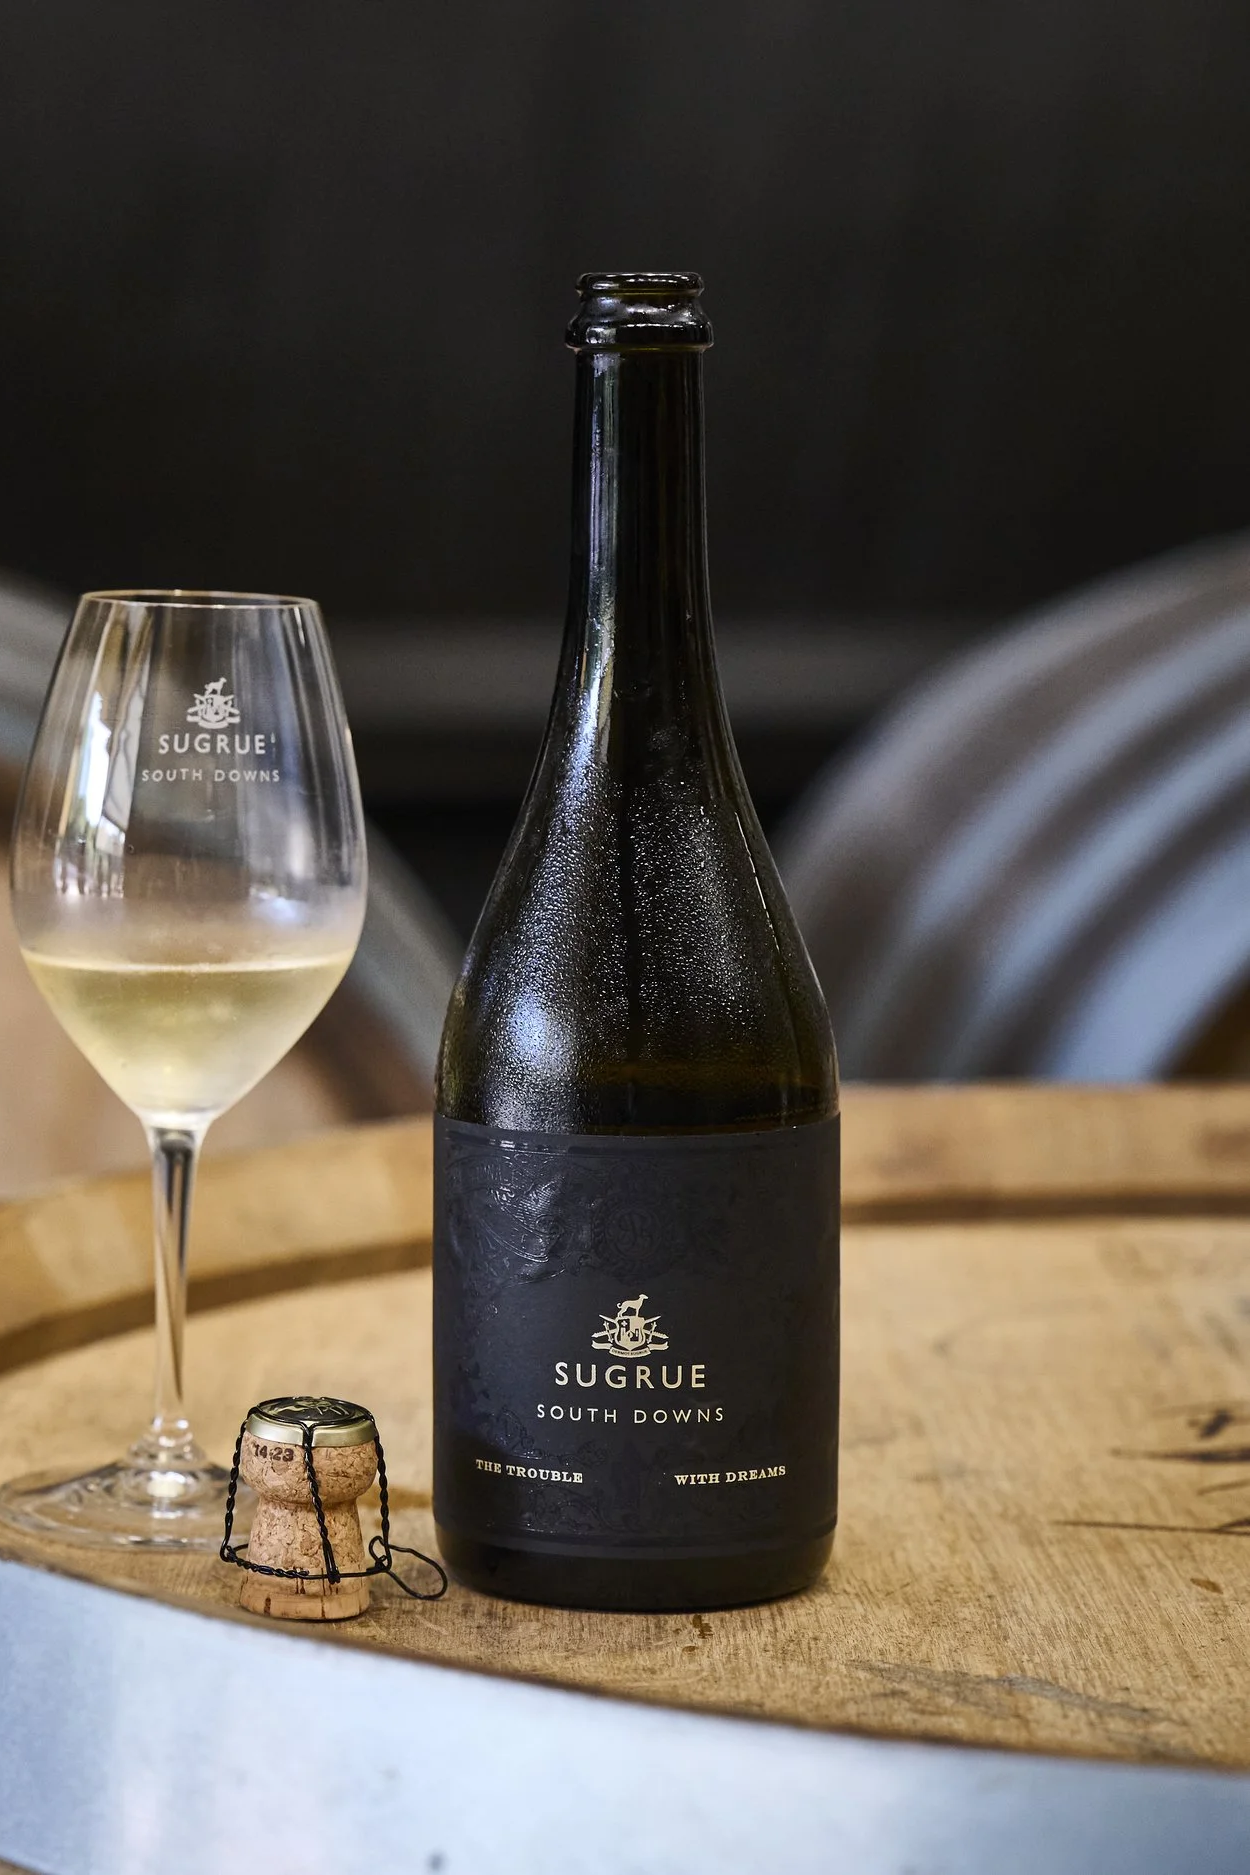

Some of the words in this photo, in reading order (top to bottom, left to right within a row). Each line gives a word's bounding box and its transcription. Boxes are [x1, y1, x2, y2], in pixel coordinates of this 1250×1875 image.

[158, 733, 266, 755] SUGRUE
[141, 768, 203, 783] SOUTH
[214, 769, 280, 783] DOWNS
[555, 1361, 706, 1389] SUGRUE
[537, 1403, 617, 1424] SOUTH
[633, 1407, 724, 1424] DOWNS
[476, 1459, 502, 1474] THE
[505, 1464, 583, 1484] TROUBLE
[673, 1473, 721, 1486] WITH
[725, 1465, 786, 1483] DREAMS
